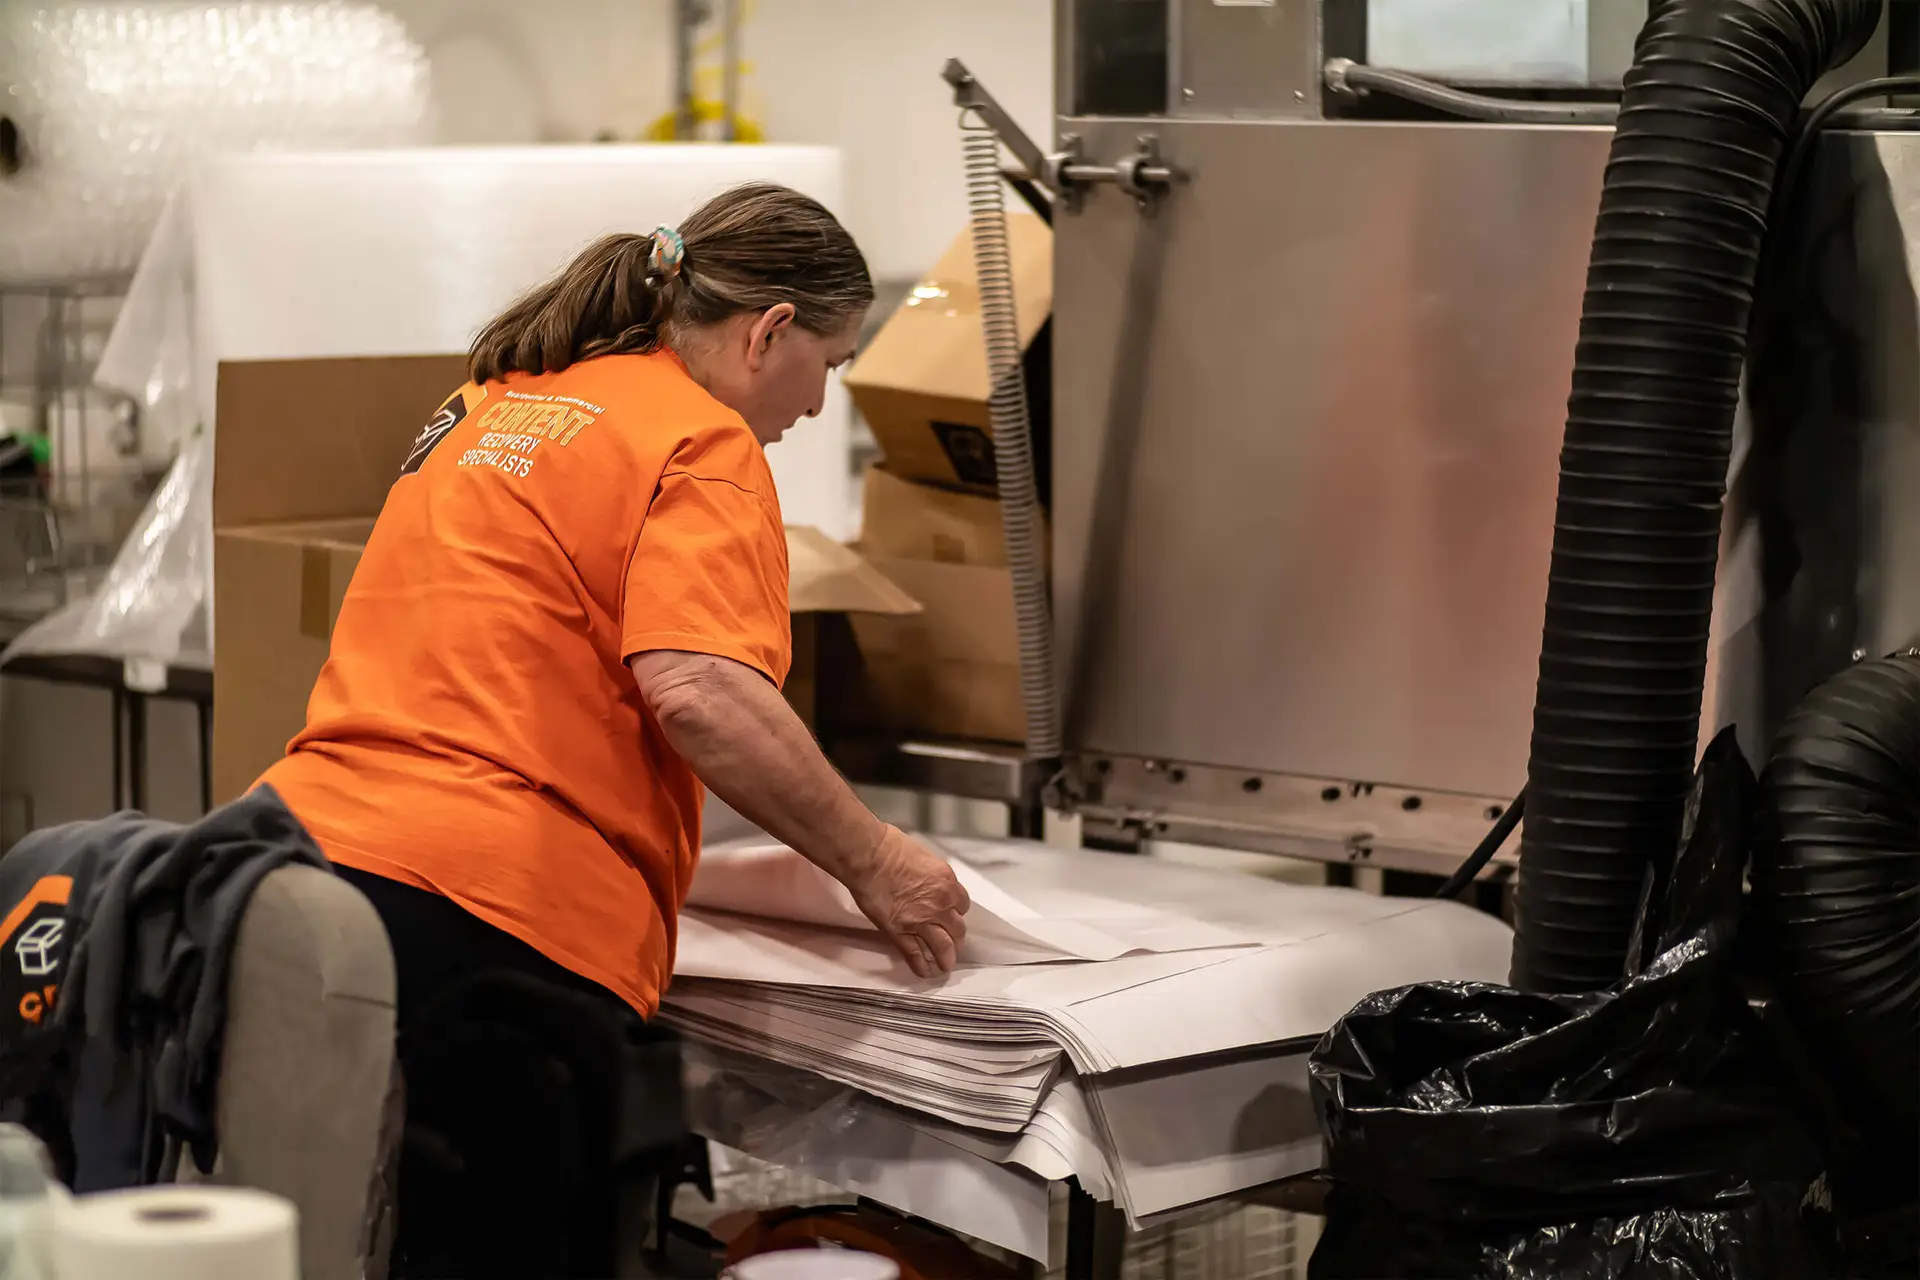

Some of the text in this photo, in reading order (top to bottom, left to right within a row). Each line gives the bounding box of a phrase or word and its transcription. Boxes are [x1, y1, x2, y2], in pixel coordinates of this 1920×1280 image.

[504, 390, 547, 401] Residential
[555, 395, 607, 414] Commercial
[477, 401, 596, 447] CONTENT
[477, 432, 541, 454] RECOVERY
[457, 449, 534, 478] SPECIALISTS
